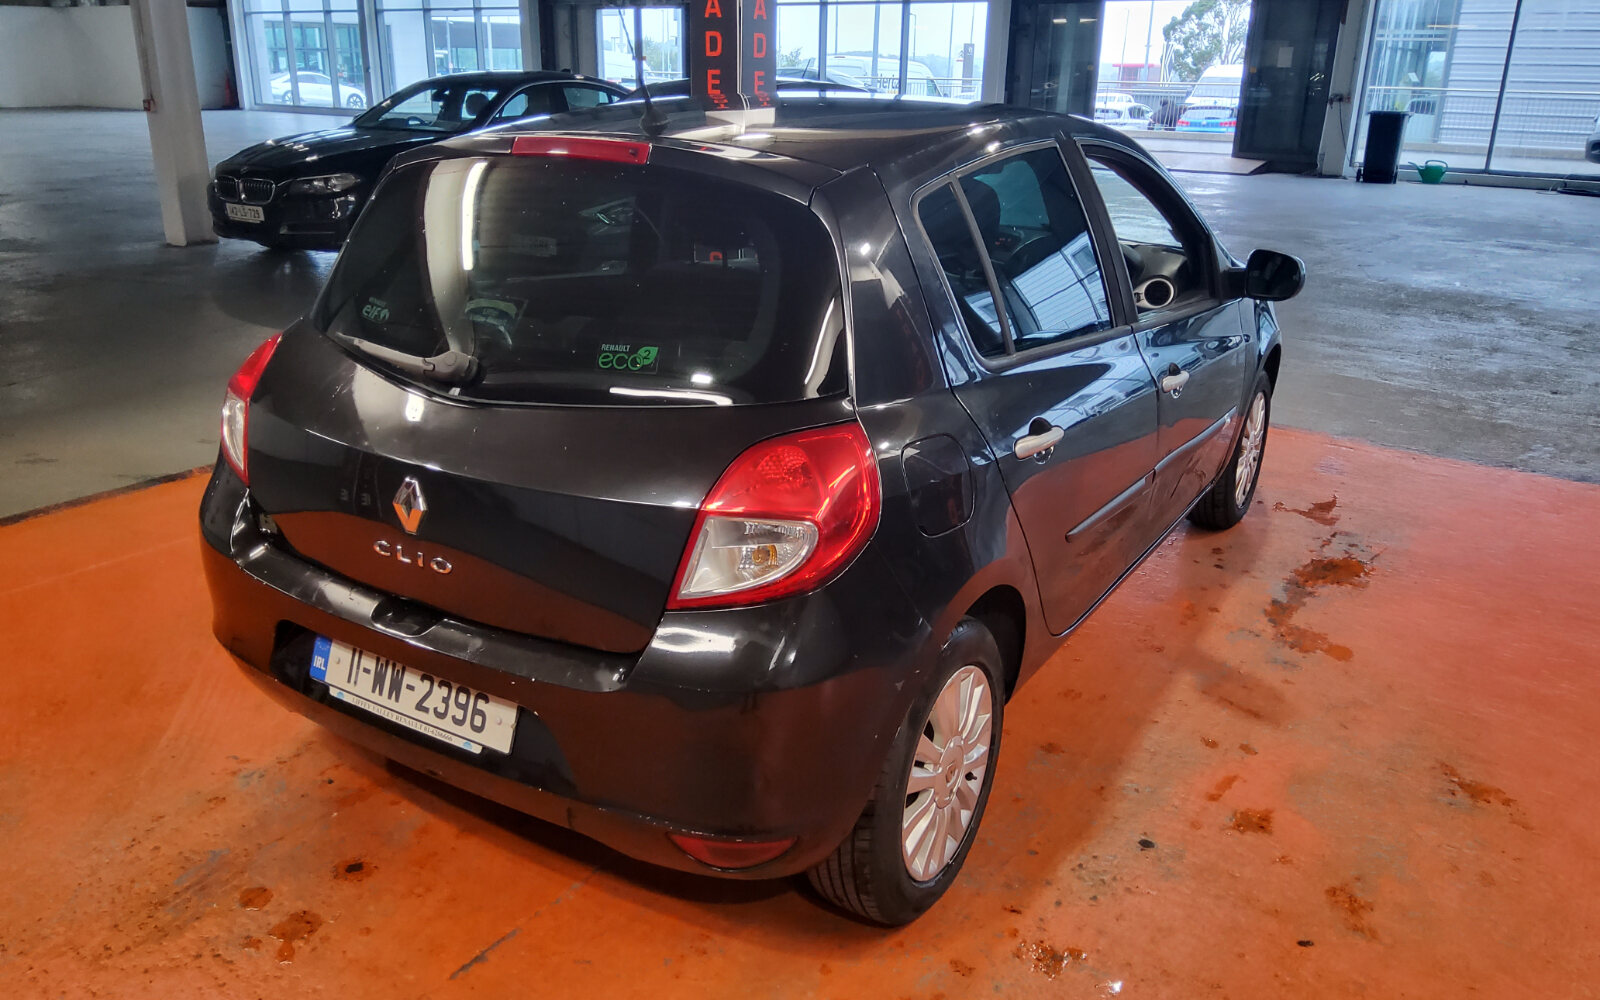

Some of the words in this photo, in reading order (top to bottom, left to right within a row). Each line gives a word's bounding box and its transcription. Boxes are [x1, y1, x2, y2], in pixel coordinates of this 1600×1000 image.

[601, 344, 631, 352] RENAULT
[373, 540, 453, 574] CLIO
[313, 655, 326, 671] IRL
[347, 647, 490, 734] 11-WW-2396
[372, 705, 394, 719] VALLEY
[395, 714, 423, 731] RENAULT
